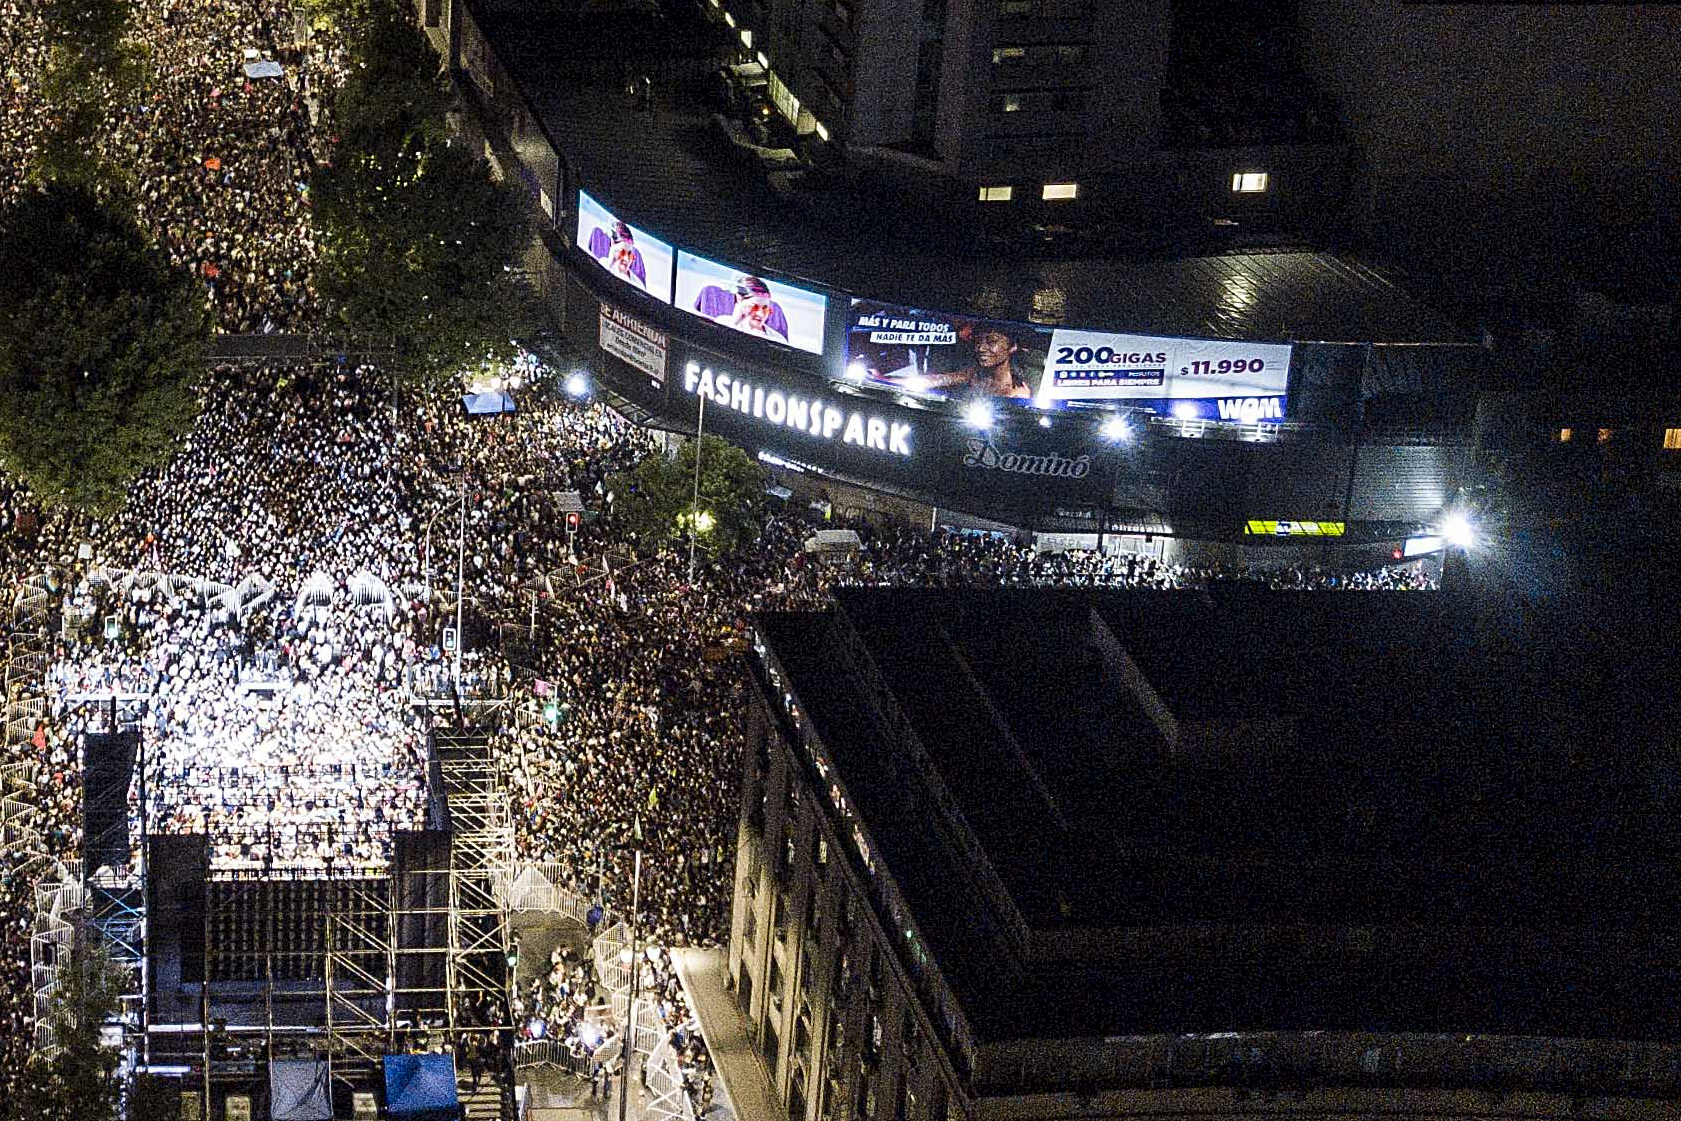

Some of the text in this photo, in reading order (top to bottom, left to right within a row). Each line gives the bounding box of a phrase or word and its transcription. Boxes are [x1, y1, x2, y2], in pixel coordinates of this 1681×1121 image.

[858, 315, 950, 332] MÁS Y PARA TODOS
[906, 334, 915, 342] TE
[918, 334, 931, 342] DA
[1056, 347, 1167, 364] 200 GIGAS
[1092, 378, 1117, 386] PARA
[1118, 378, 1161, 386] SIEMPRE
[684, 361, 912, 456] FASHIONSPARK
[1217, 397, 1283, 421] WOM
[963, 437, 1090, 479] Dominó
